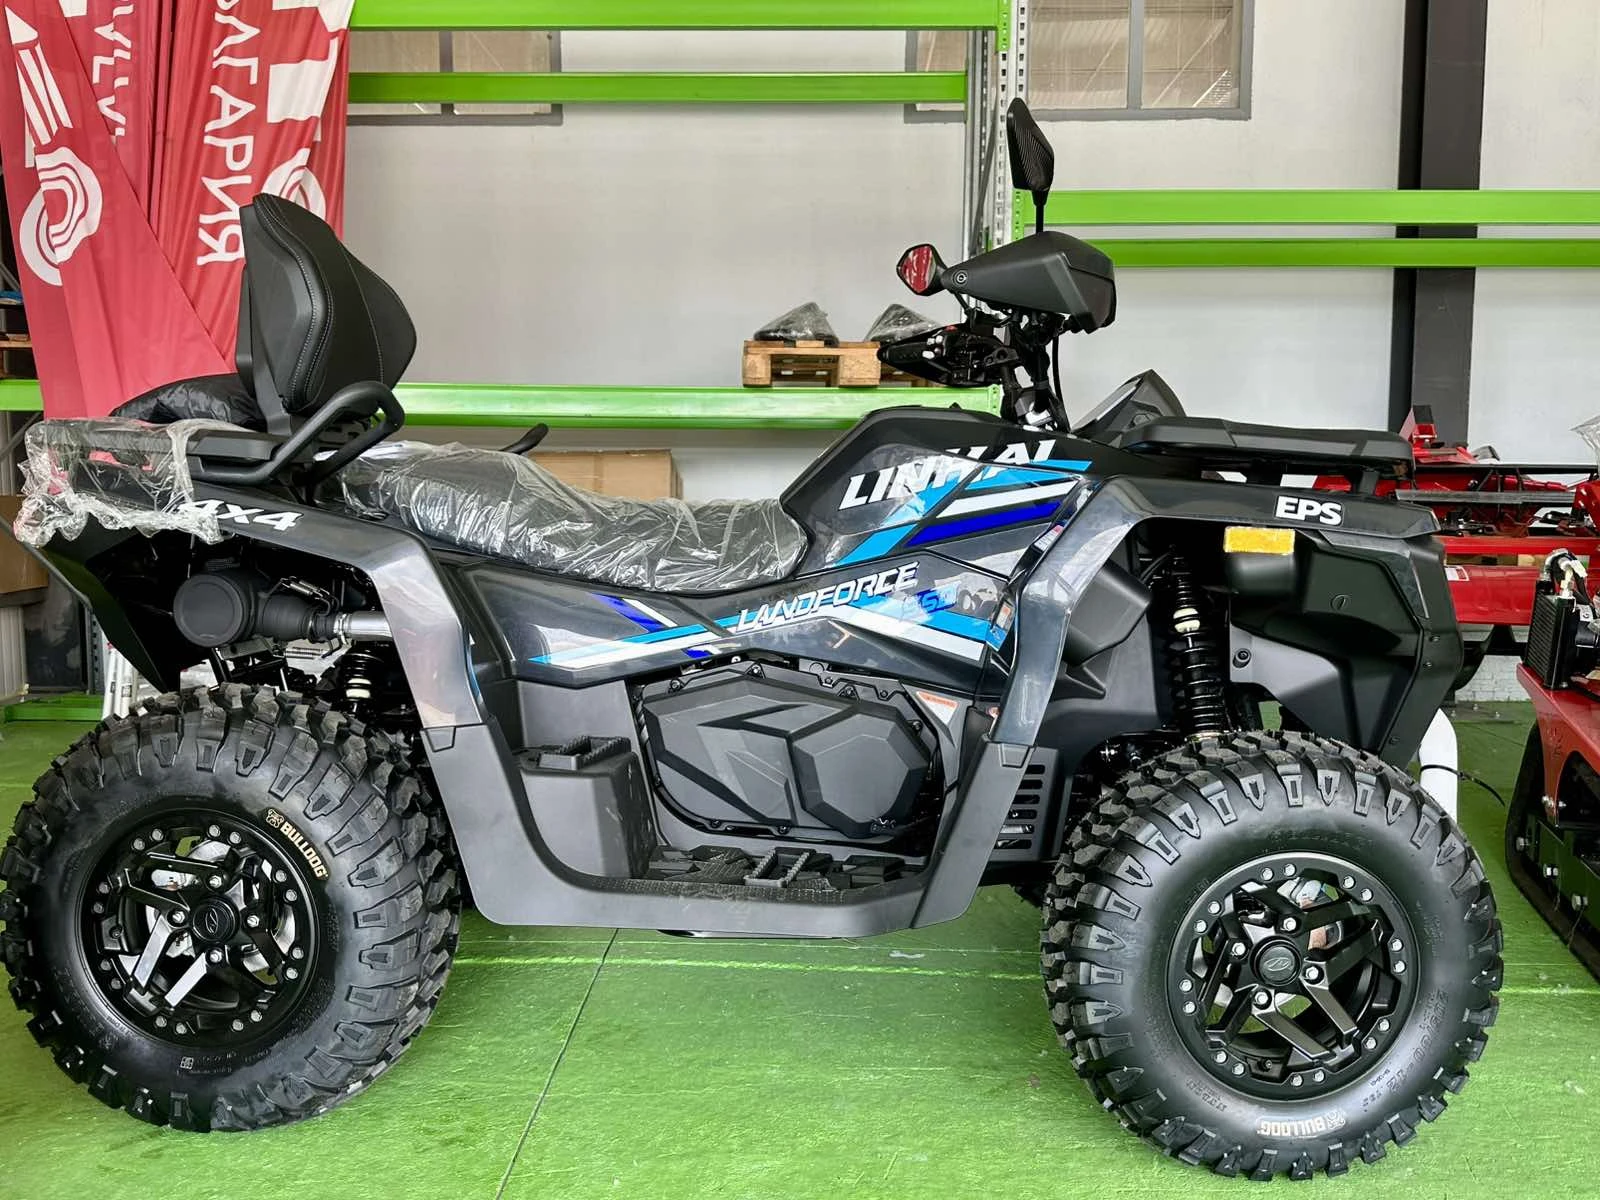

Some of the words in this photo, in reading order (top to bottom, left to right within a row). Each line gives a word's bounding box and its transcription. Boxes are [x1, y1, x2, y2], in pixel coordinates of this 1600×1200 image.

[1275, 496, 1342, 526] EPS
[734, 562, 920, 635] LANDFORCE
[280, 821, 329, 878] BULLDOG
[1256, 1116, 1326, 1137] BULLDOG
